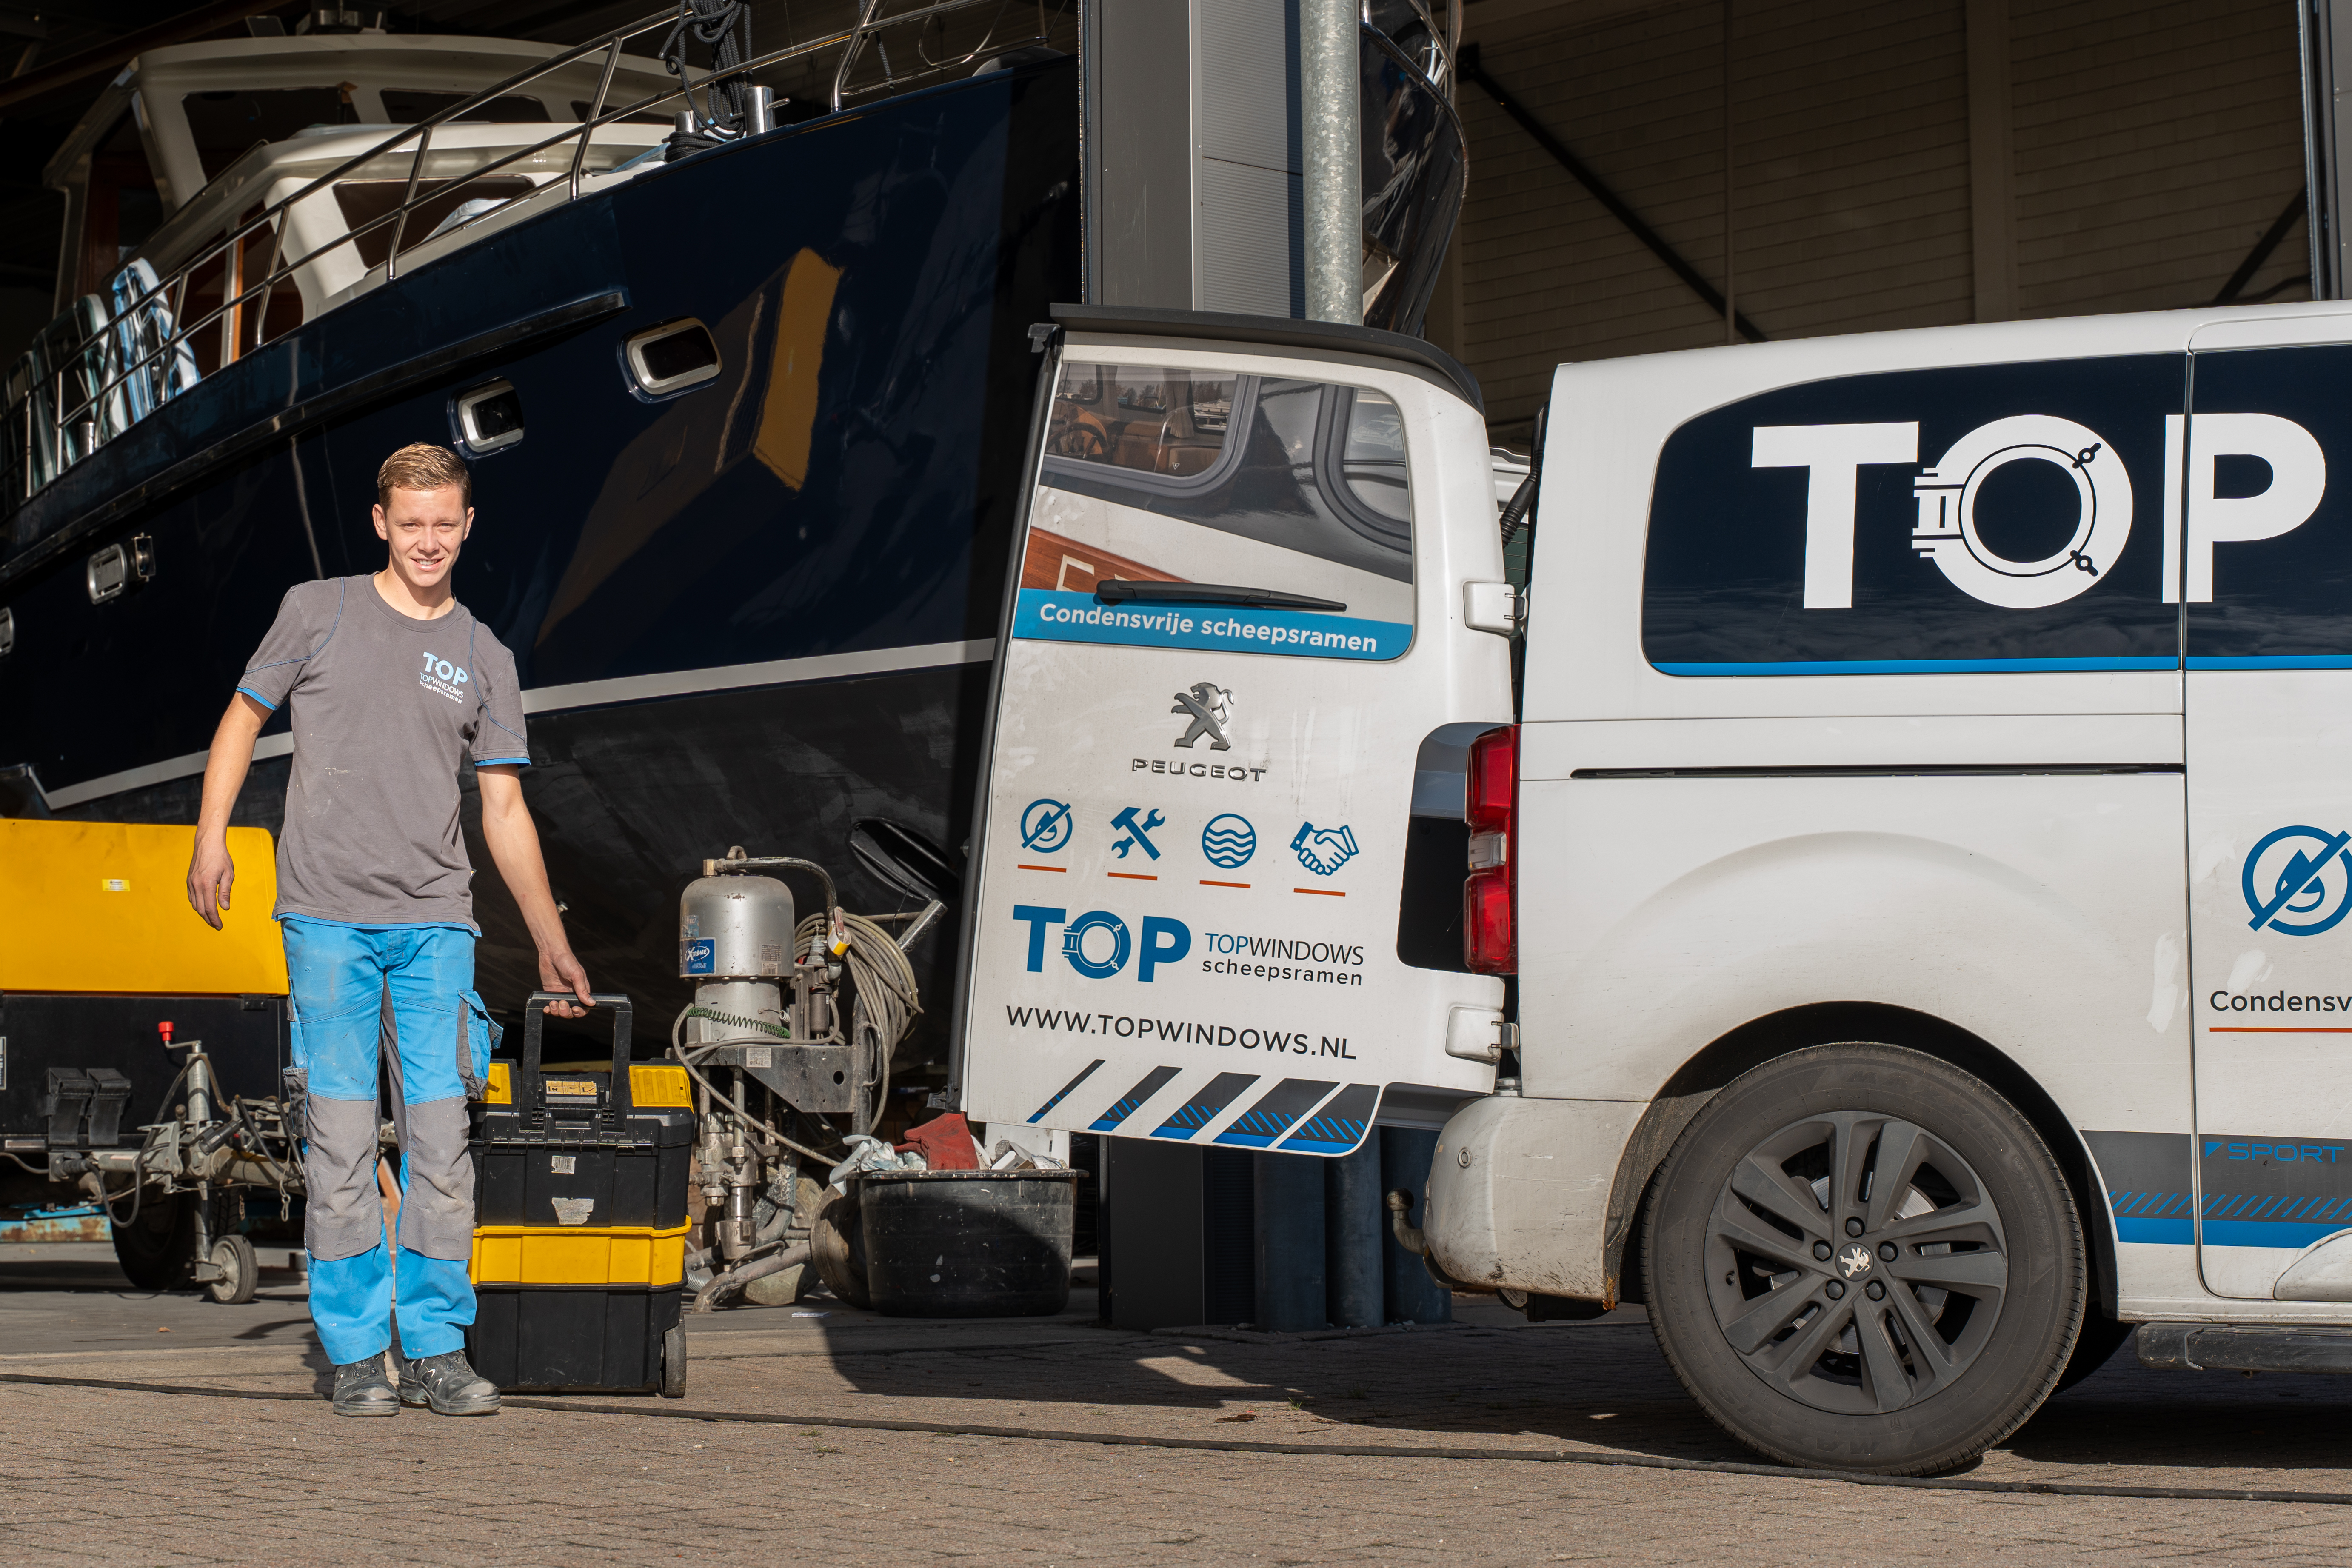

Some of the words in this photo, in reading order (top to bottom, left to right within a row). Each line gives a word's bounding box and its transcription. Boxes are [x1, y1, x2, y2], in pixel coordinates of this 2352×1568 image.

[1751, 414, 2326, 609] TOP
[1039, 603, 1193, 635] Condensvrije
[1201, 618, 1376, 652] scheepsramen
[420, 672, 463, 698] TOPWINDOWS
[423, 652, 468, 685] TOP
[419, 680, 462, 703] scheepsramen
[1132, 758, 1266, 782] PEUGEOT
[1013, 905, 1191, 982] TOP
[1205, 933, 1364, 965] TOPWINDOWS
[1202, 958, 1362, 986] scheepsramen
[1006, 1005, 1356, 1060] WWW.TOPWINDOWS.NL
[1845, 1071, 2006, 1154] MAXXIS
[2228, 1142, 2345, 1163] SPORT
[2009, 1167, 2038, 1220] 215/60
[1713, 1381, 1881, 1454] MAXXIS
